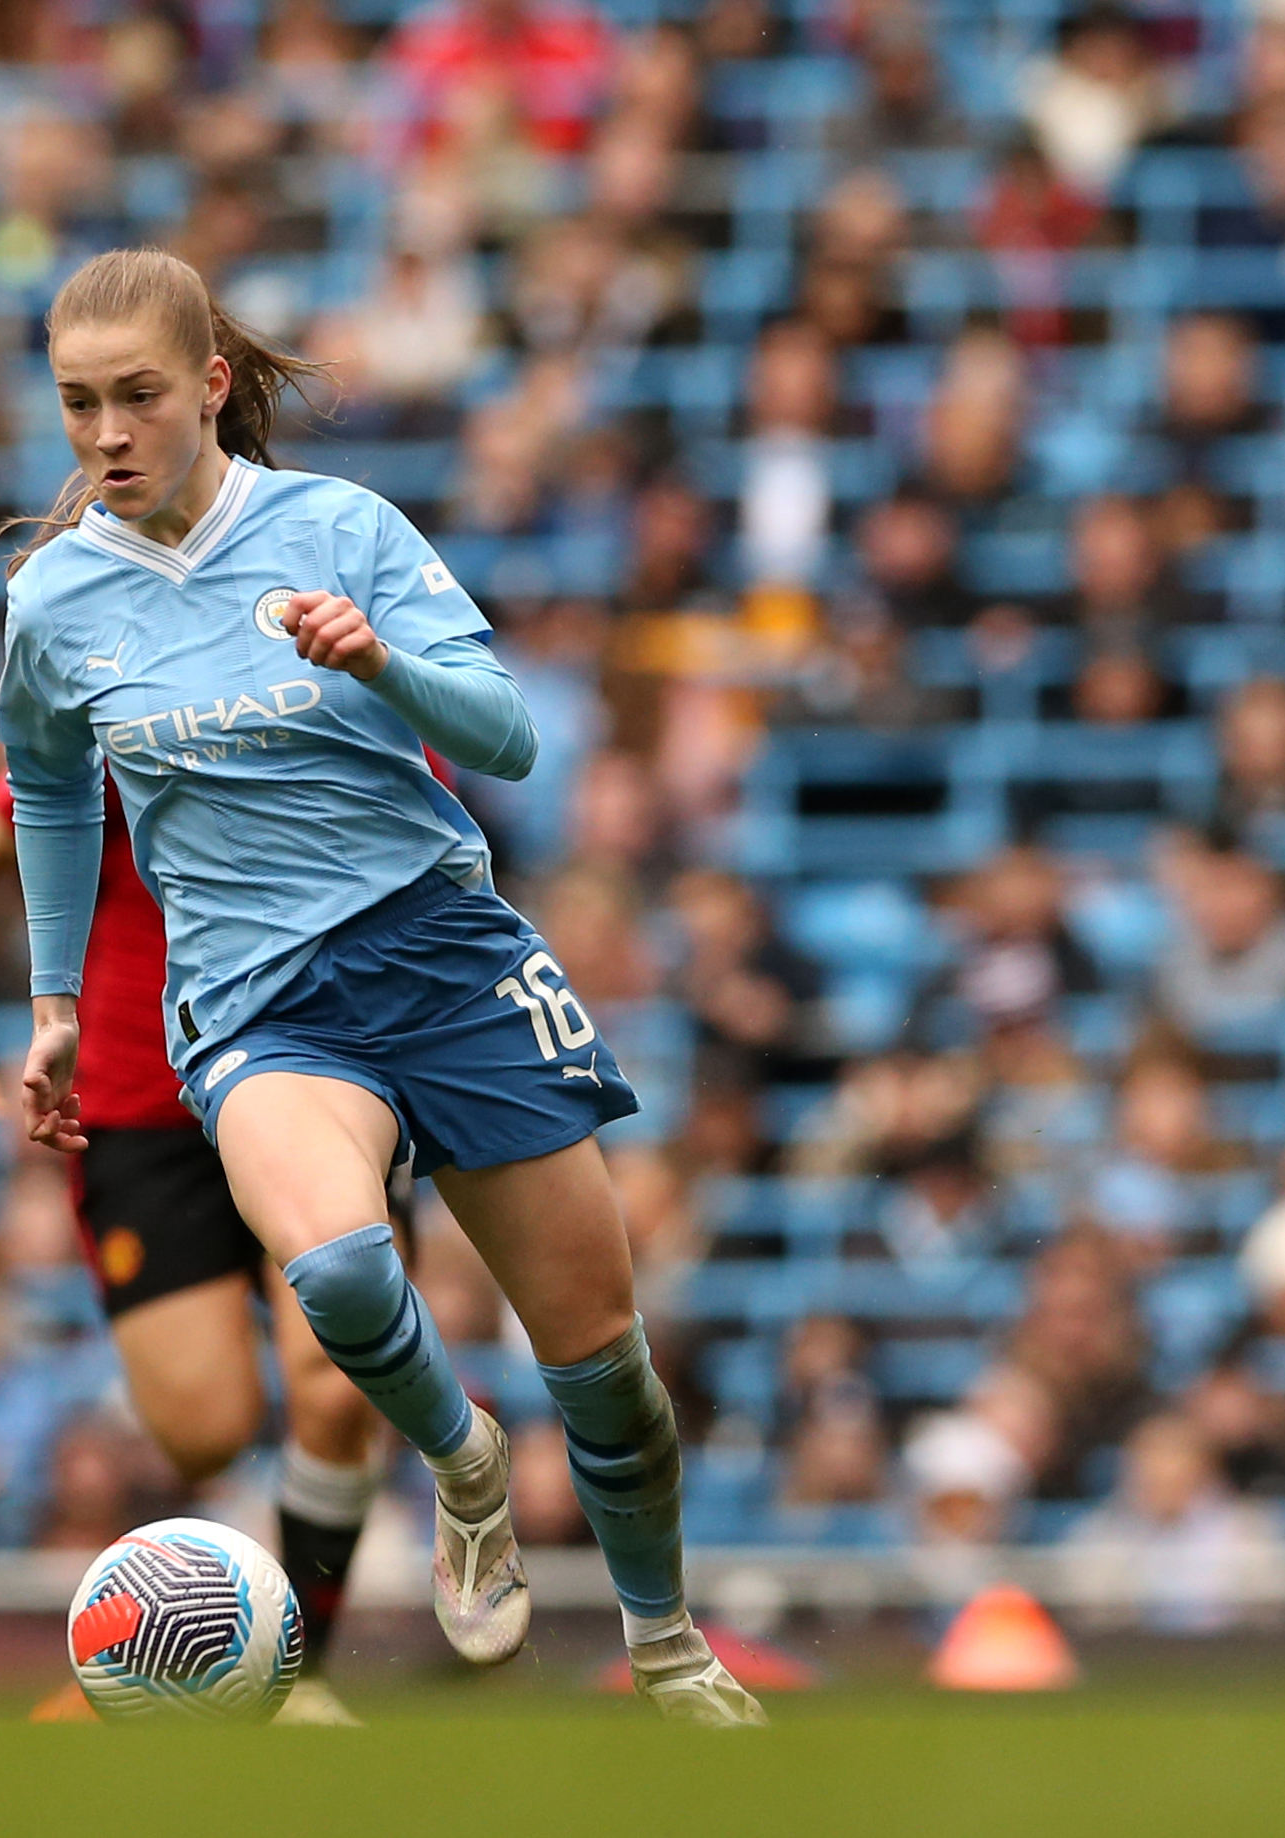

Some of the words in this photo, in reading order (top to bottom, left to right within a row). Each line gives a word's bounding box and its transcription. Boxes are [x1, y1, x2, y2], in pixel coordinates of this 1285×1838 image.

[106, 678, 322, 755] ETIHAD
[155, 727, 291, 775] AIRWAYS
[494, 950, 596, 1062] 16
